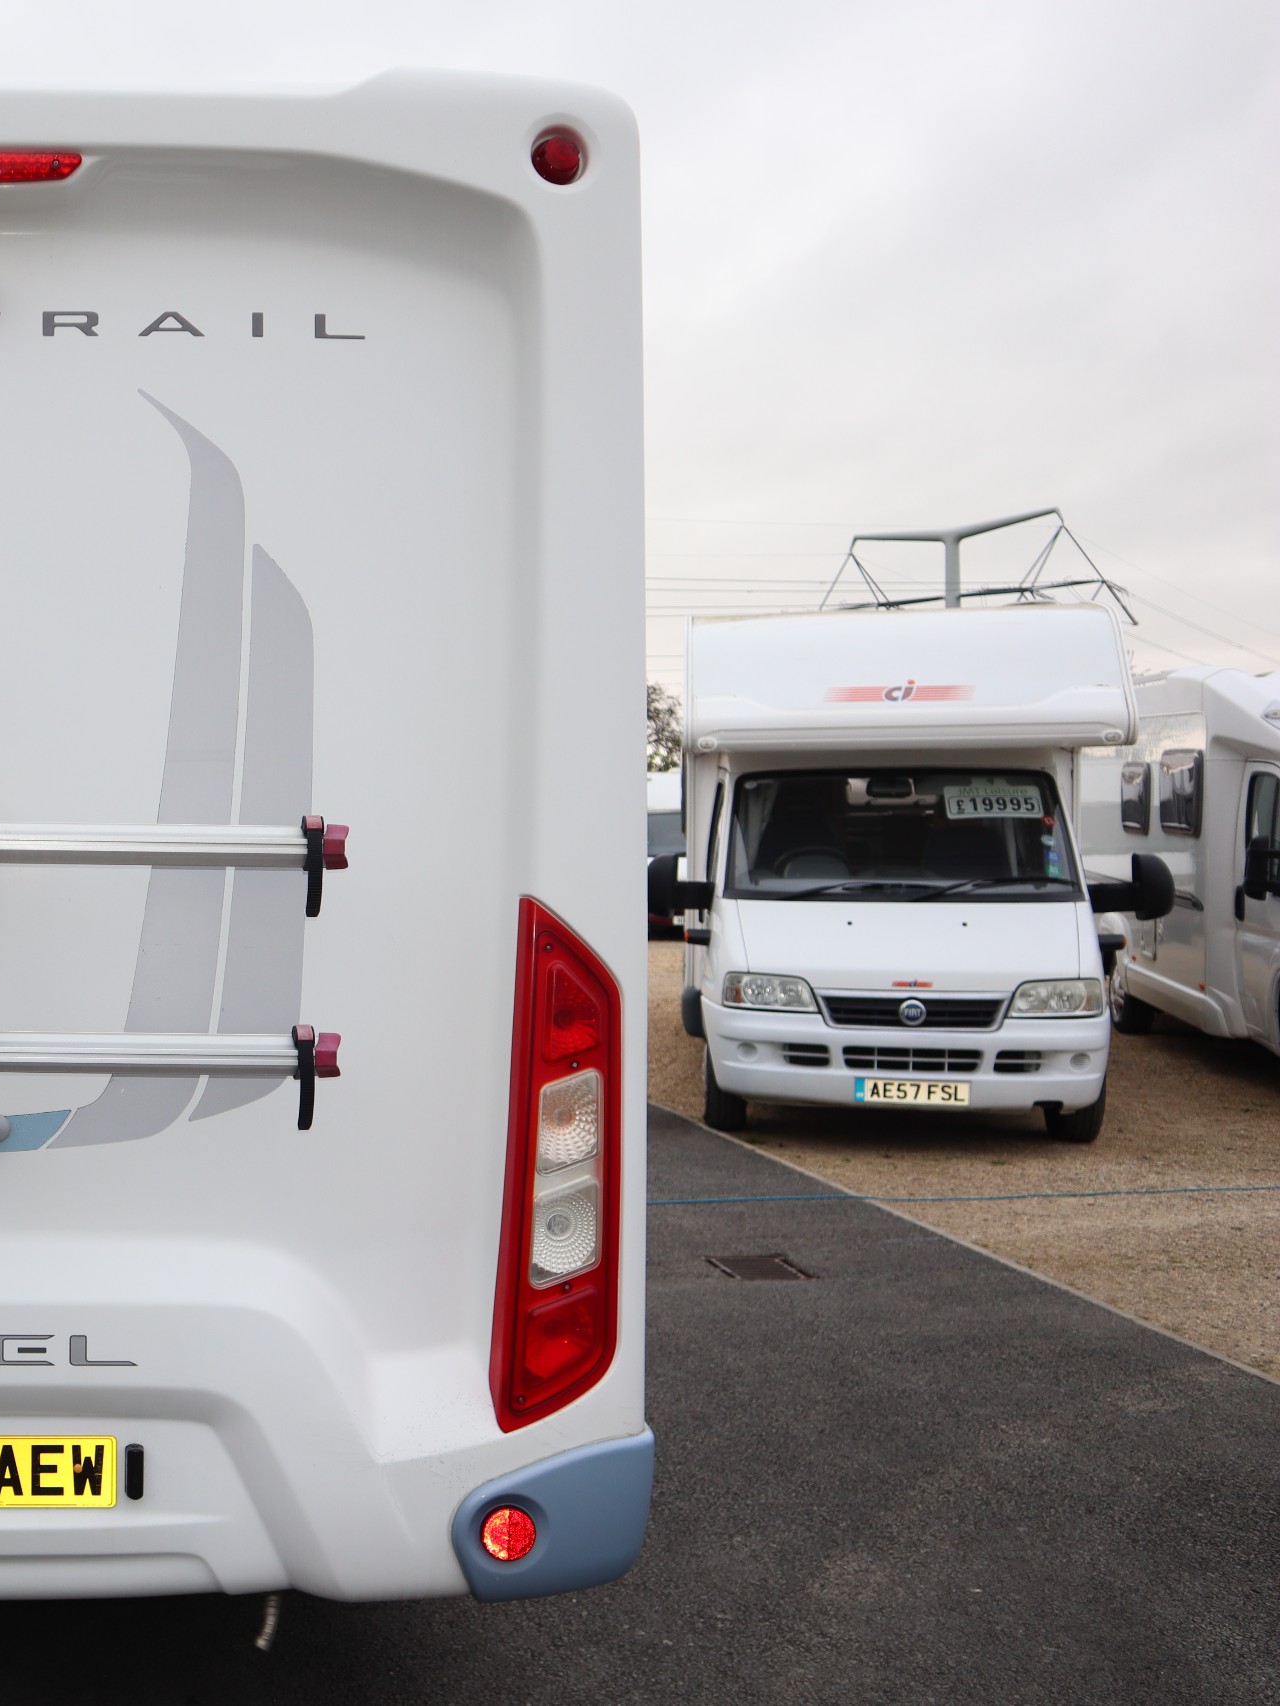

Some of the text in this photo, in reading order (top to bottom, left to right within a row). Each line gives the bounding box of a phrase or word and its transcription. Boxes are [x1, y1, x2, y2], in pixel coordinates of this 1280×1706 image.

[956, 796, 1036, 815] £19995
[904, 1008, 922, 1018] FIAT
[870, 1081, 966, 1103] AE57 FSL
